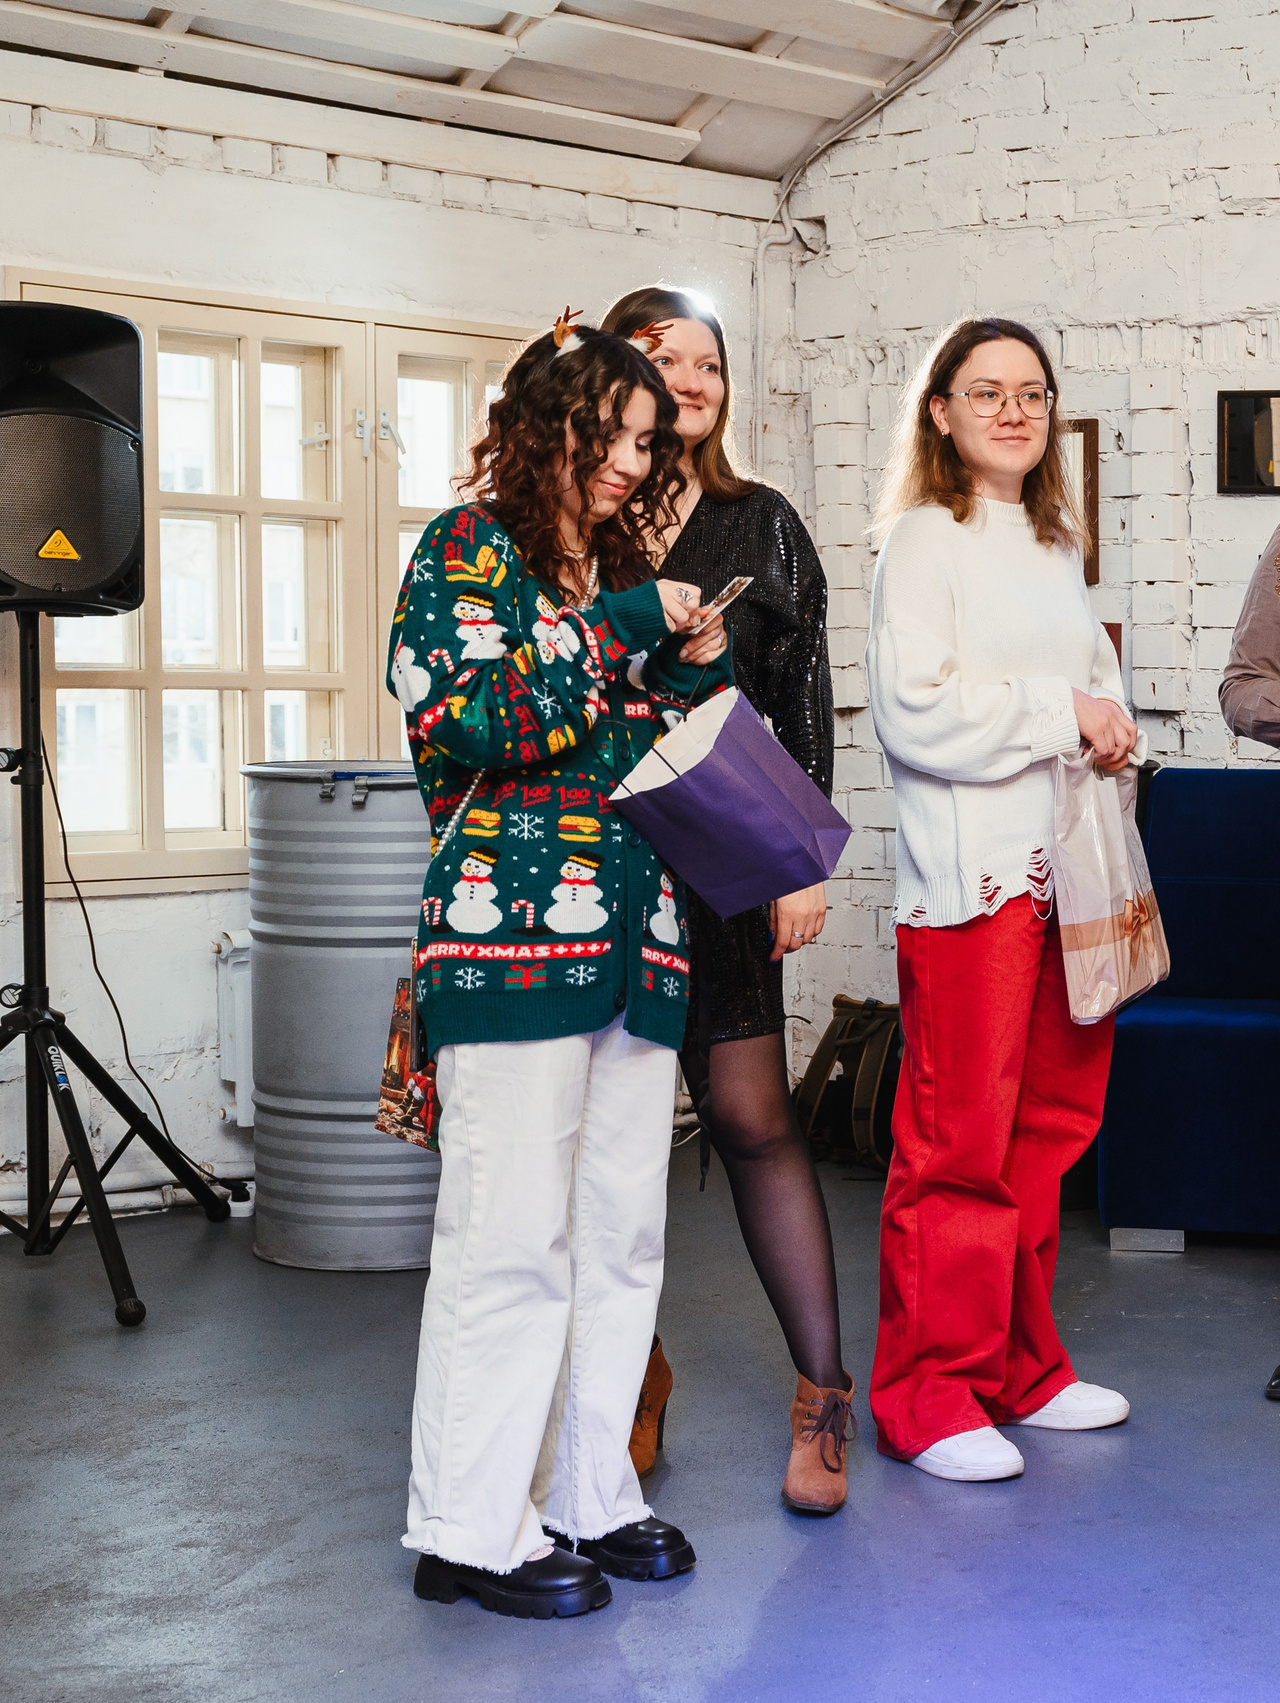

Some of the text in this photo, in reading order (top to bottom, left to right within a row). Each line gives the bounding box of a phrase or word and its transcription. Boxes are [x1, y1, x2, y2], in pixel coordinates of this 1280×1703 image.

[521, 785, 551, 802] 100
[556, 785, 591, 803] 100
[477, 945, 551, 961] XMAS
